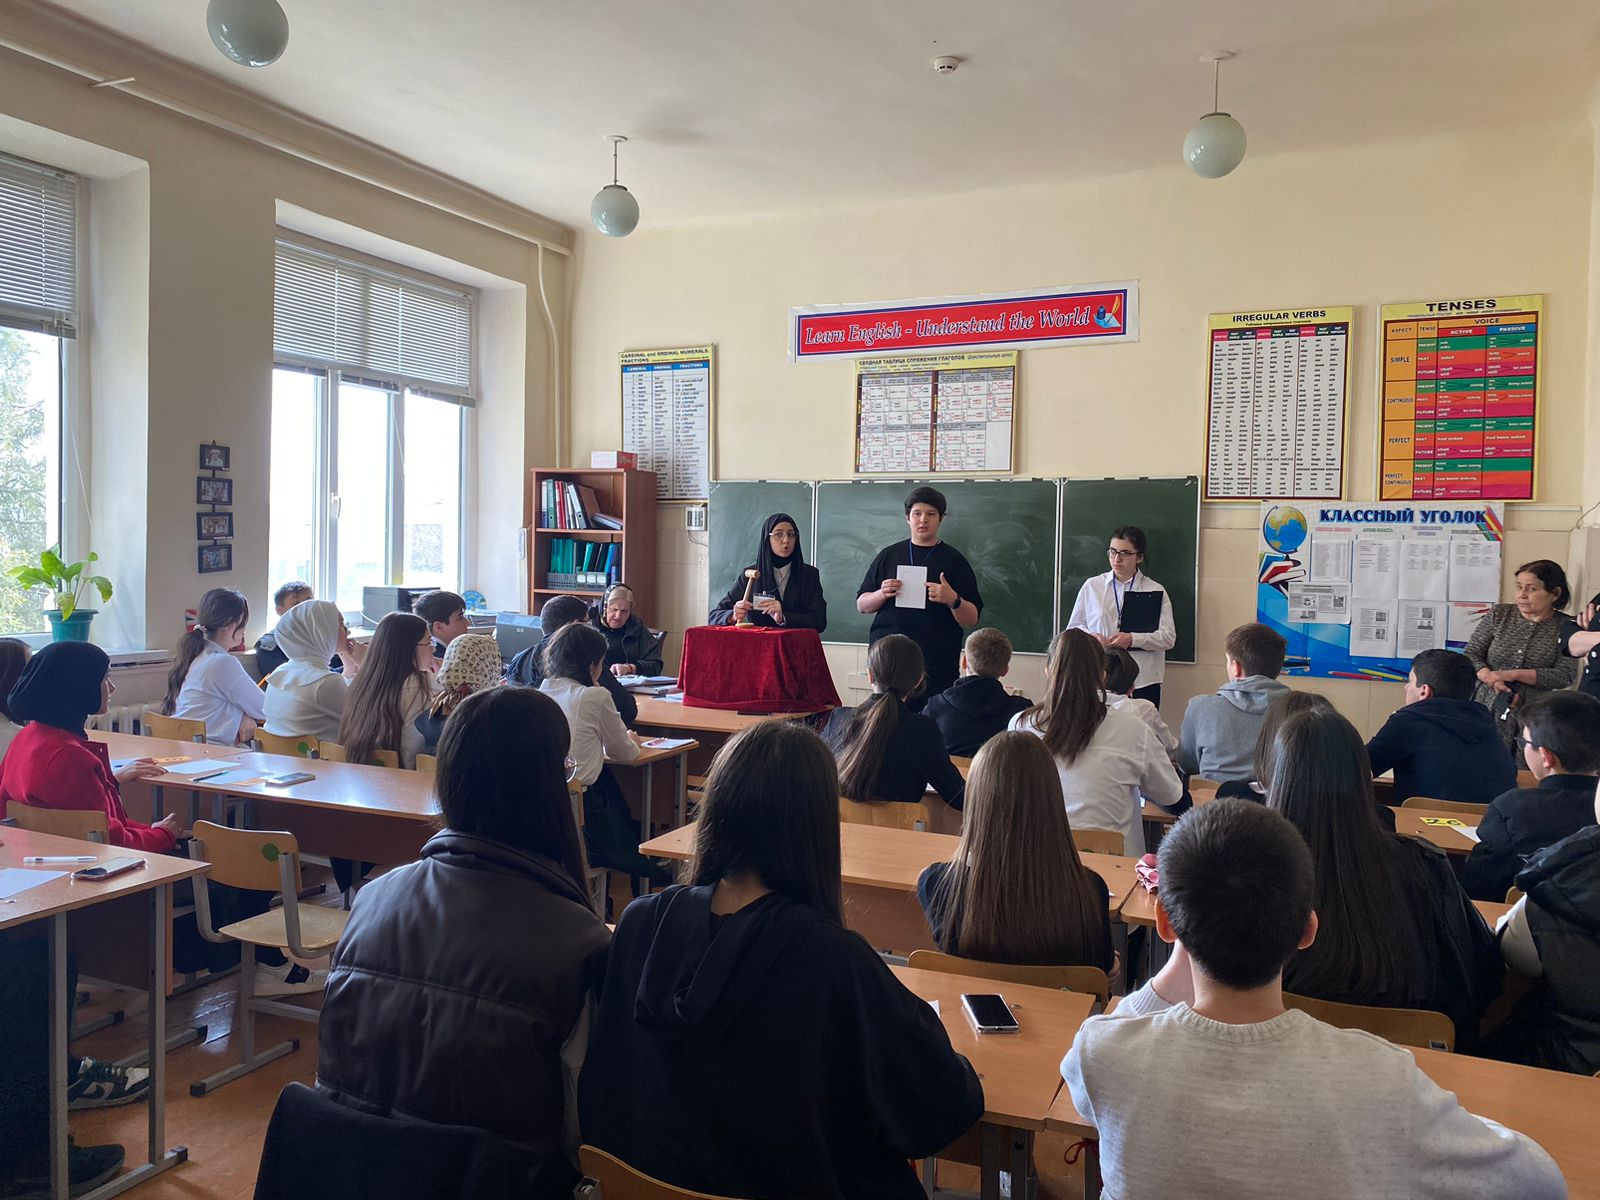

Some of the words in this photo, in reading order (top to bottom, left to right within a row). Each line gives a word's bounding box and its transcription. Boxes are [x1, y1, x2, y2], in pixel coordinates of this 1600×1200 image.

[1425, 299, 1497, 312] TENSES
[1232, 312, 1289, 323] IRREGULAR
[1292, 310, 1326, 319] VERBS
[804, 328, 845, 346] Learn
[848, 322, 902, 347] English
[916, 313, 1005, 338] Understand
[1008, 312, 1034, 330] the
[1038, 306, 1090, 328] World
[907, 356, 938, 364] СПРЯЖЕНИЯ
[938, 354, 965, 362] ГЛАГОЛОВ
[1390, 356, 1410, 364] SIMPLE
[1319, 508, 1414, 523] КЛАССНЫЙ
[1420, 510, 1487, 524] УГОЛОК
